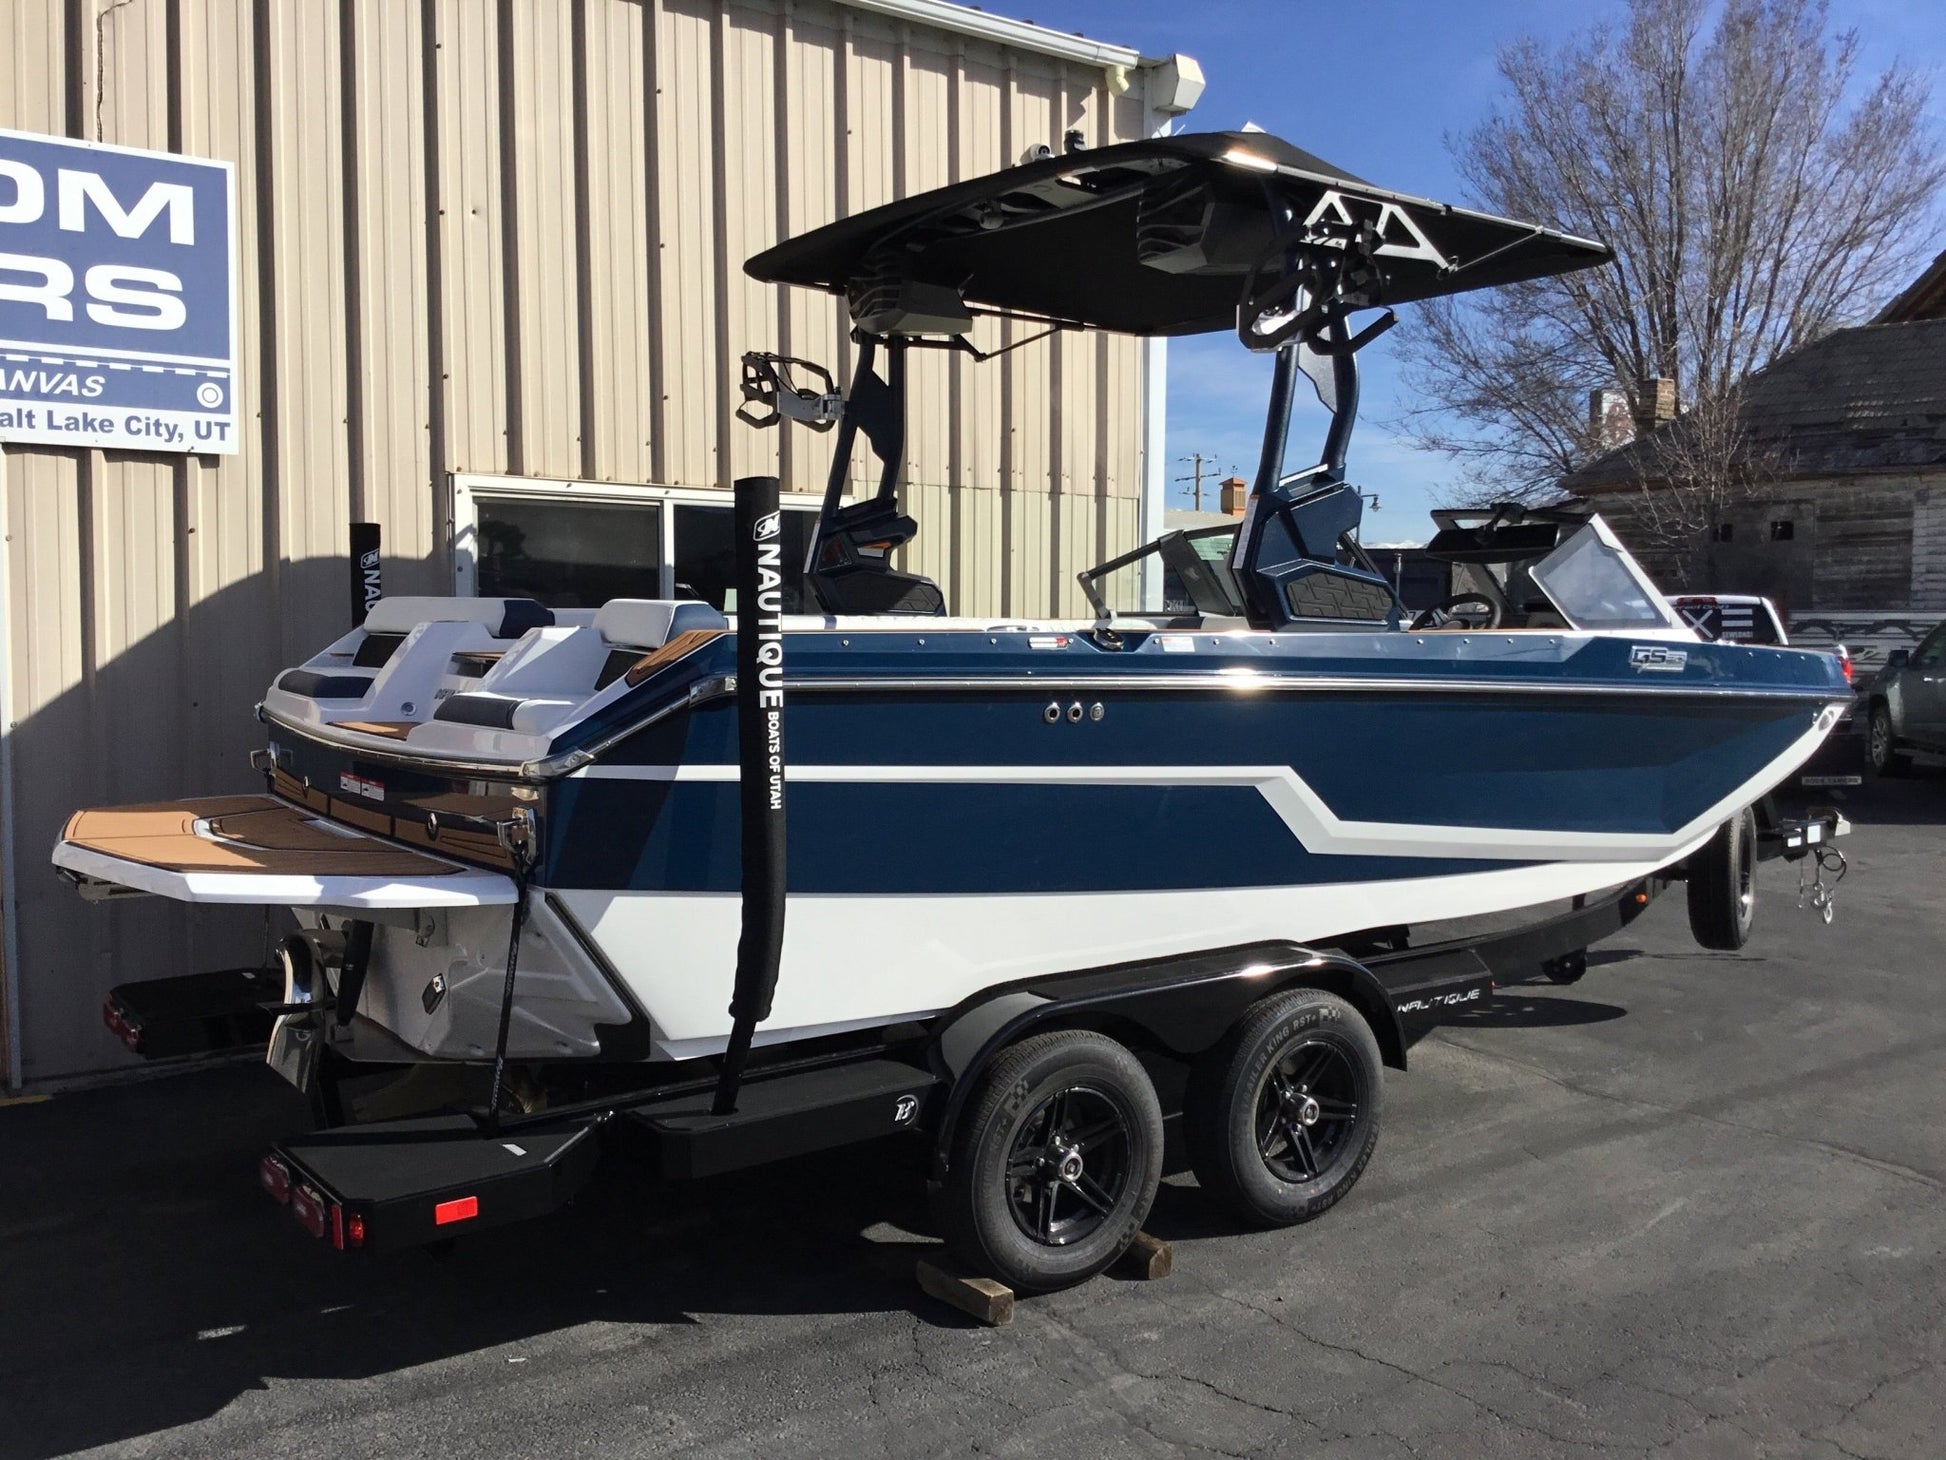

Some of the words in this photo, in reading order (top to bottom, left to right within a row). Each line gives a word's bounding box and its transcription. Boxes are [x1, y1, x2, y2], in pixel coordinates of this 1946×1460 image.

[0, 253, 187, 331] RS
[0, 369, 106, 398] NVAS
[47, 409, 114, 434] Lake
[124, 415, 184, 443] City,
[194, 420, 231, 441] UT
[757, 544, 783, 708] NAUTIQUE
[767, 711, 780, 754] BOATS
[769, 755, 781, 773] OF
[769, 775, 782, 810] UTAH
[1266, 1025, 1290, 1053] KING
